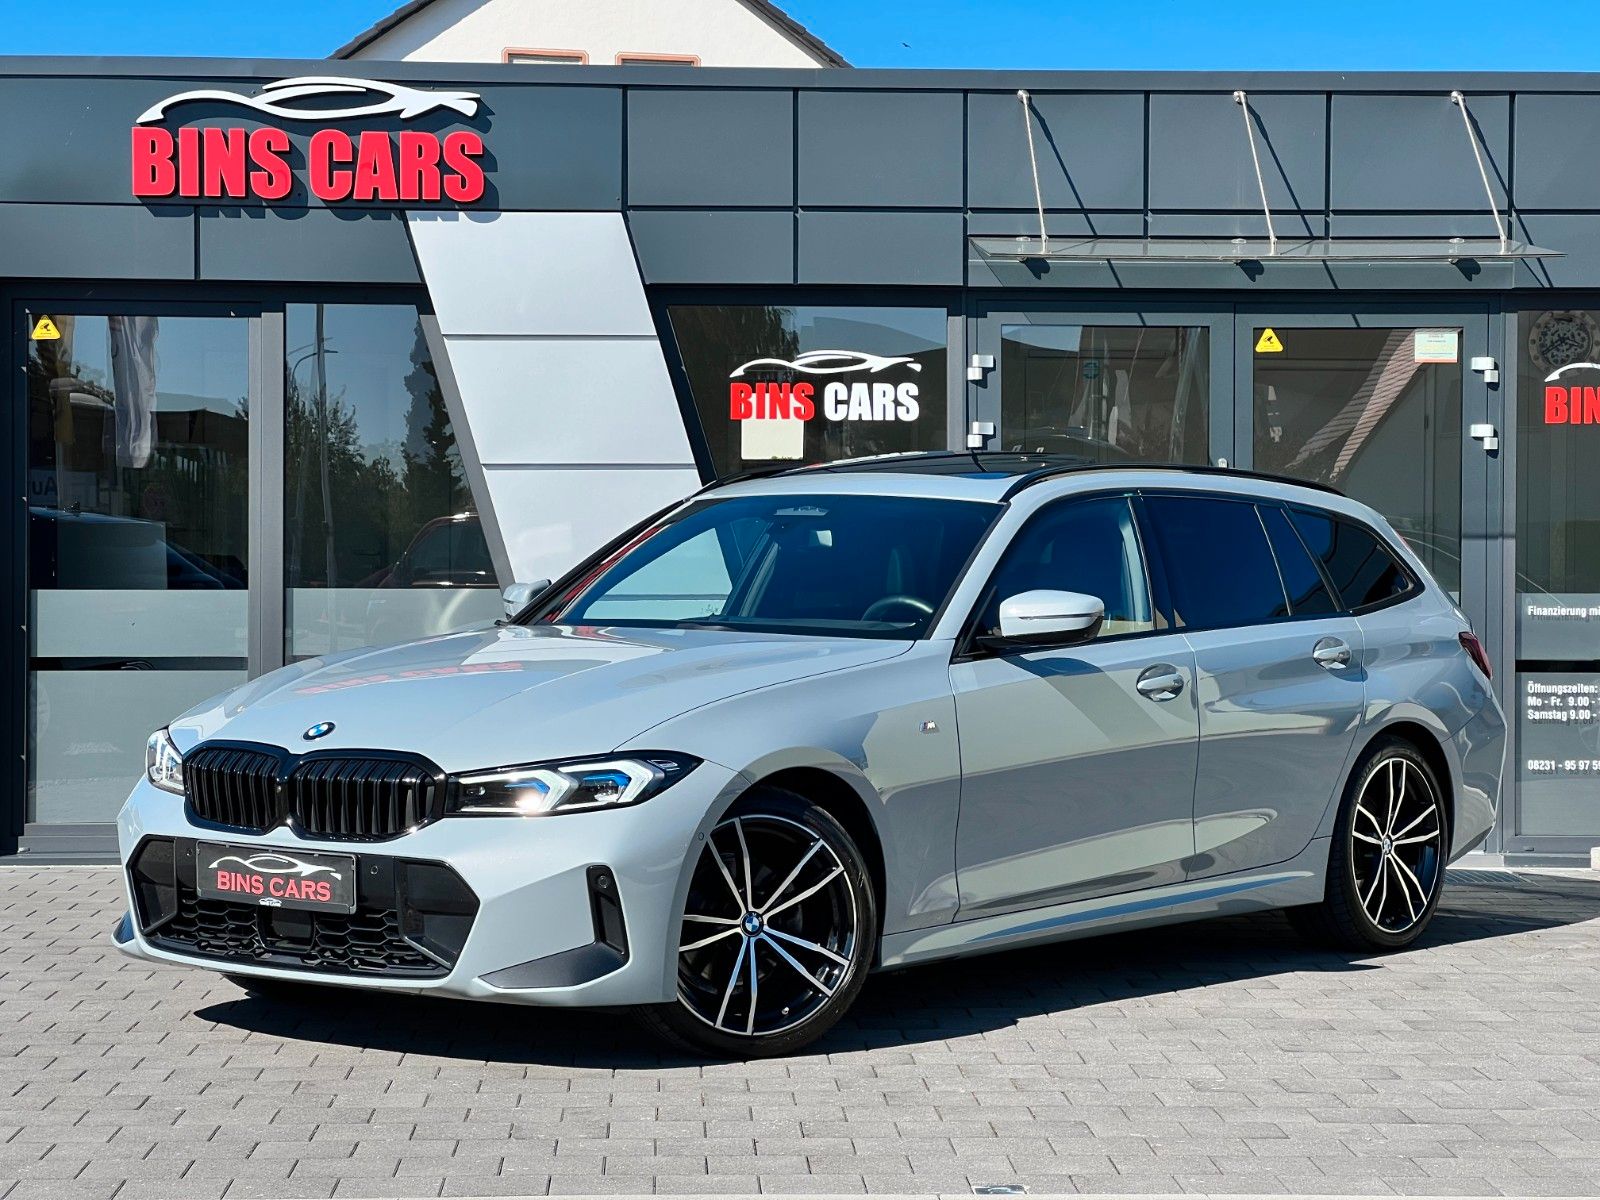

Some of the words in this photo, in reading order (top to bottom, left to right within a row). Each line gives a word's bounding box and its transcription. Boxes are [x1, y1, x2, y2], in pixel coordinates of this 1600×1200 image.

[131, 126, 292, 200] BINS
[309, 128, 485, 202] CARS
[730, 382, 815, 421] BINS
[824, 382, 920, 422] CARS
[1527, 605, 1587, 618] Finanzierung
[1527, 680, 1598, 695] Öffnungszeiten:
[1527, 696, 1542, 706] Mo
[1550, 696, 1563, 706] Fr.
[1568, 696, 1590, 706] 9.00
[1527, 709, 1568, 721] Samstag
[1569, 709, 1591, 720] 9.00
[1564, 759, 1577, 770] 95
[1578, 759, 1591, 770] 97
[217, 870, 265, 896] BINS
[269, 876, 332, 902] CARS
